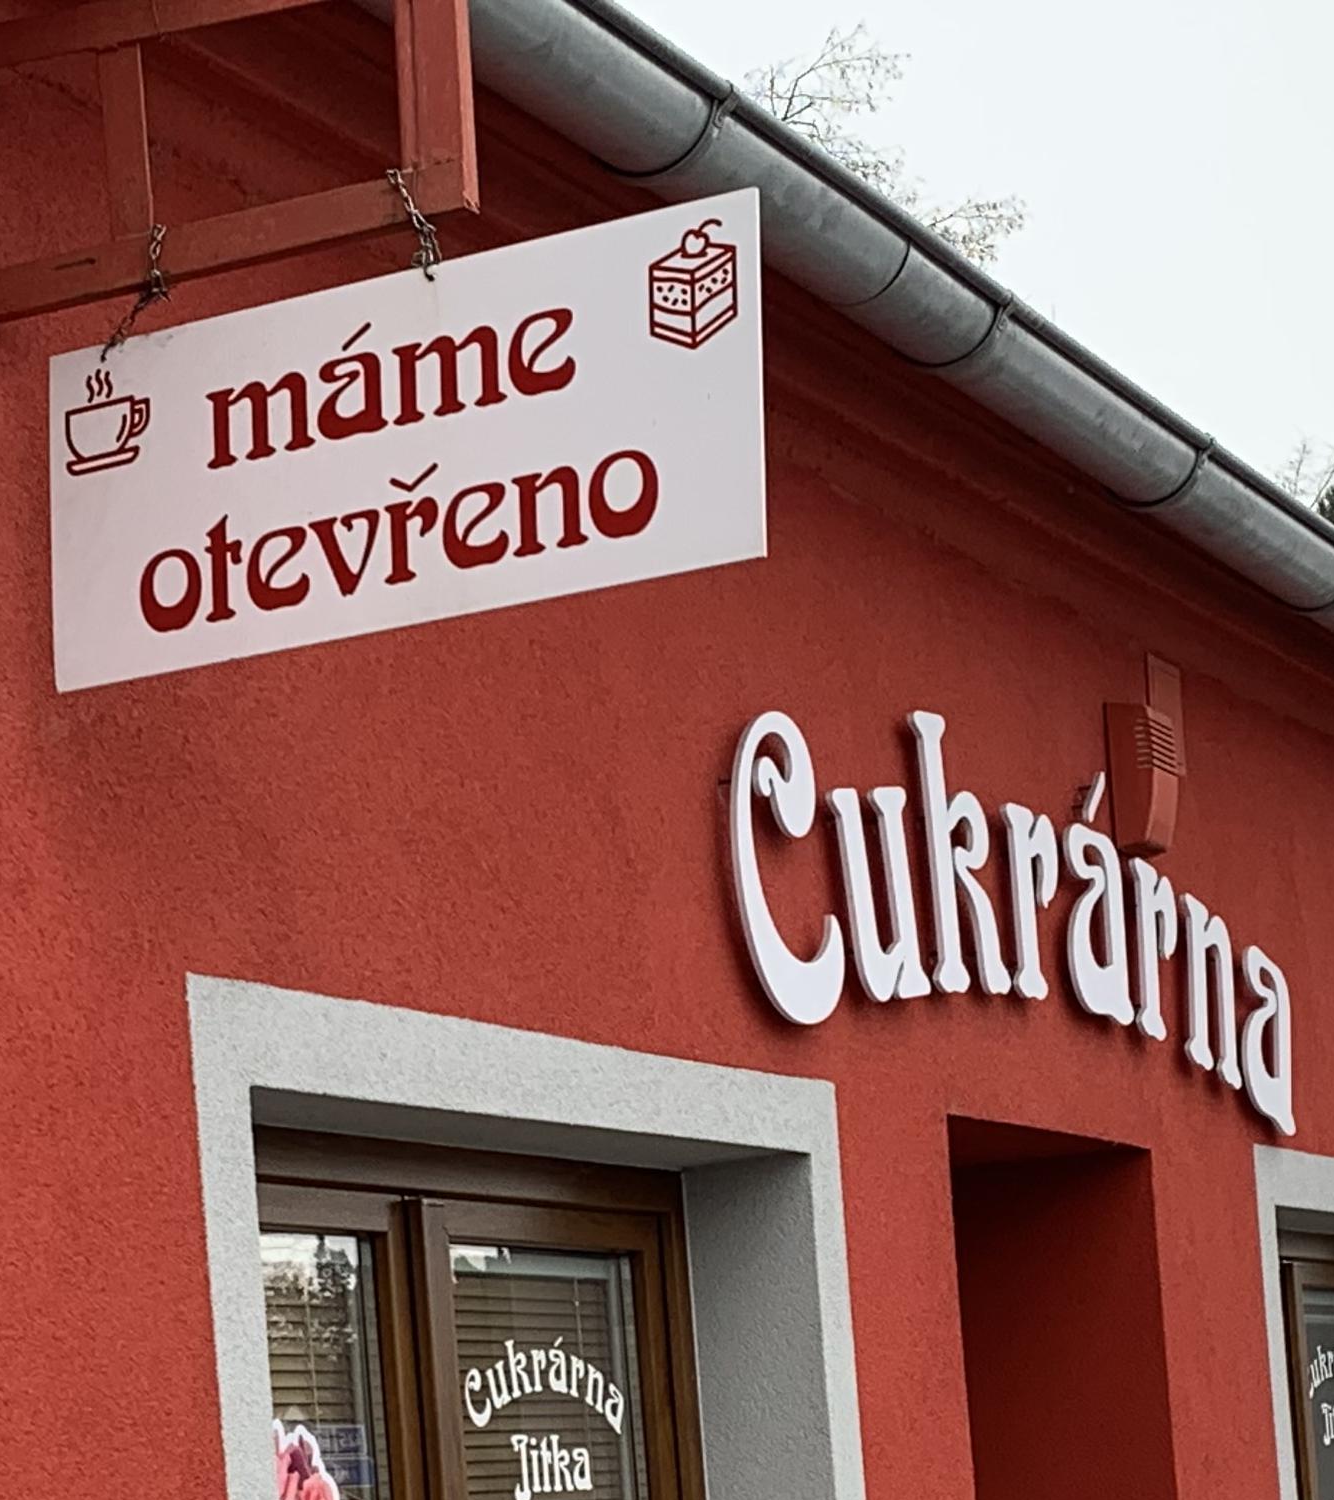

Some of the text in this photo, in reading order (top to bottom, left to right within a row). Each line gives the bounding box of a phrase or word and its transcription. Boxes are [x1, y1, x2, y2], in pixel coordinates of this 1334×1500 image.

[206, 308, 576, 470] máme
[139, 449, 660, 633] otevřeno
[729, 710, 1297, 1136] Cukrárna
[464, 1336, 625, 1434] Cukrárna
